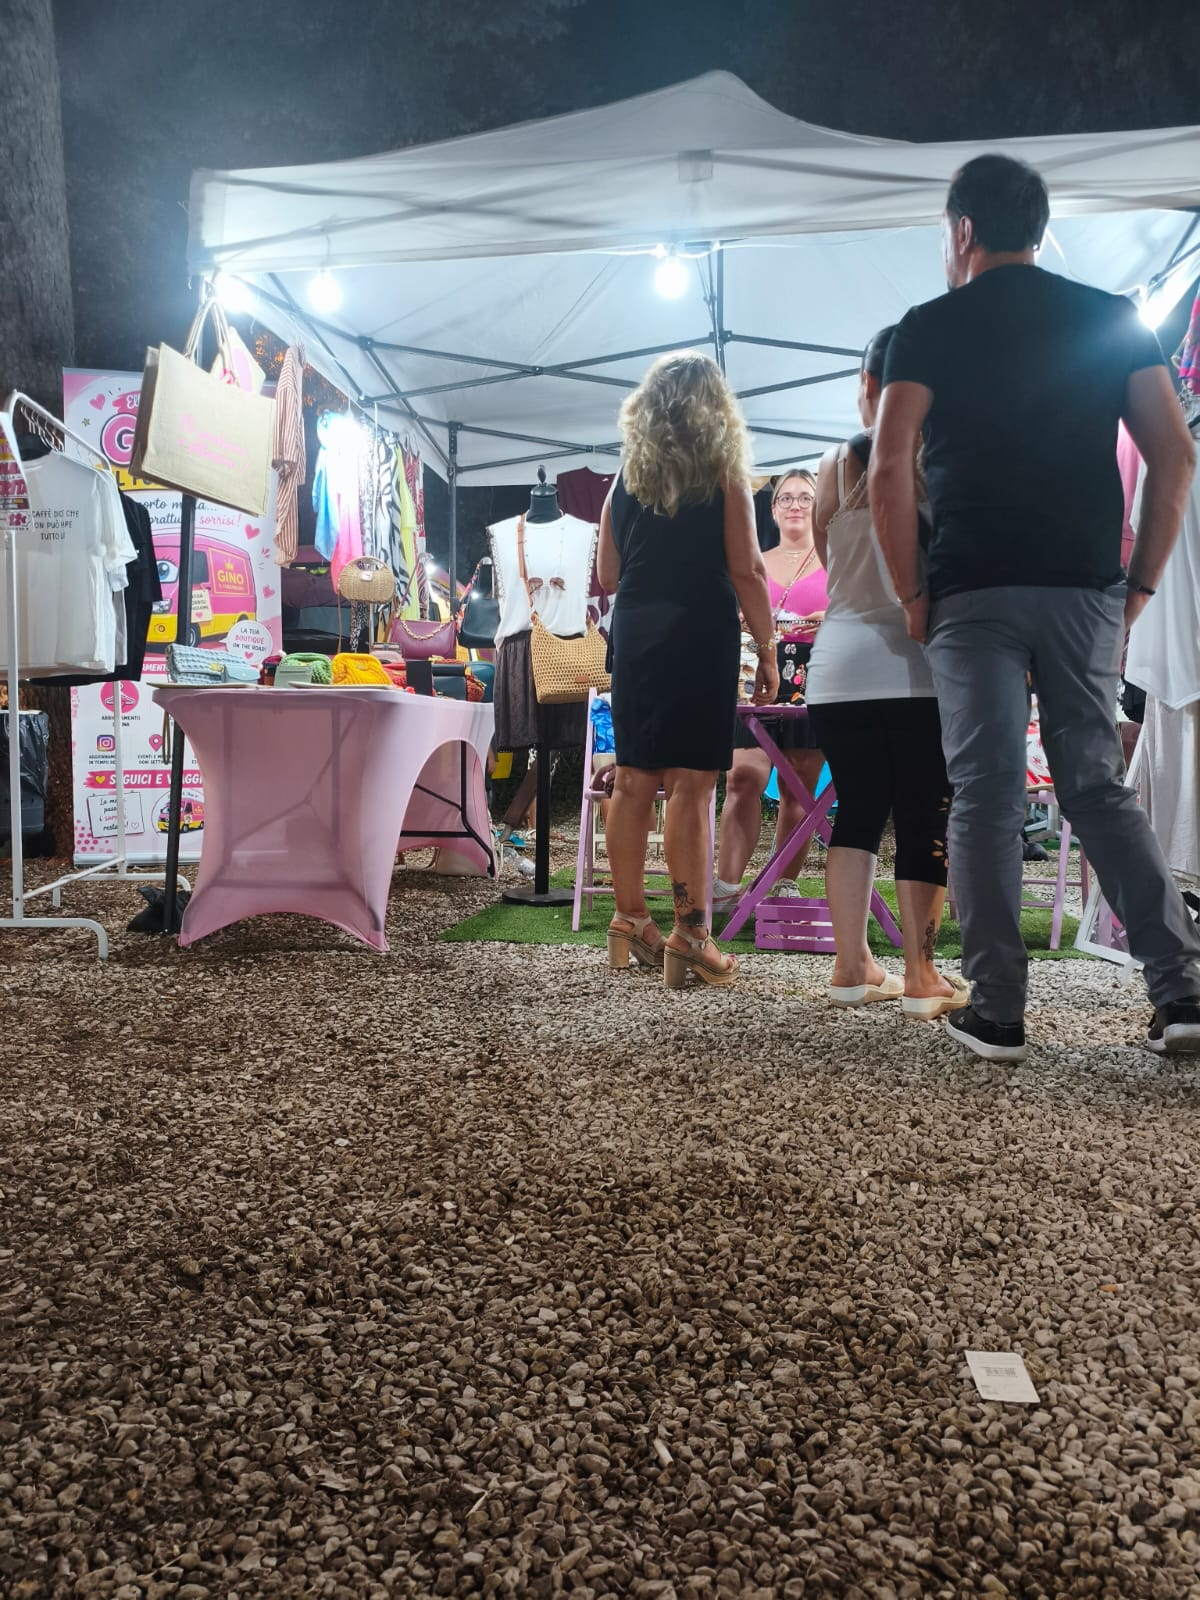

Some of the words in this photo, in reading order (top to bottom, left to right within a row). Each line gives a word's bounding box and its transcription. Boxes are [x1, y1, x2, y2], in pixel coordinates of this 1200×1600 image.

[140, 498, 167, 510] orto
[41, 532, 60, 540] TUTTO
[217, 570, 244, 584] GINO
[235, 634, 265, 644] BOUTIQUE
[109, 773, 152, 785] SGUICI
[155, 774, 163, 785] E
